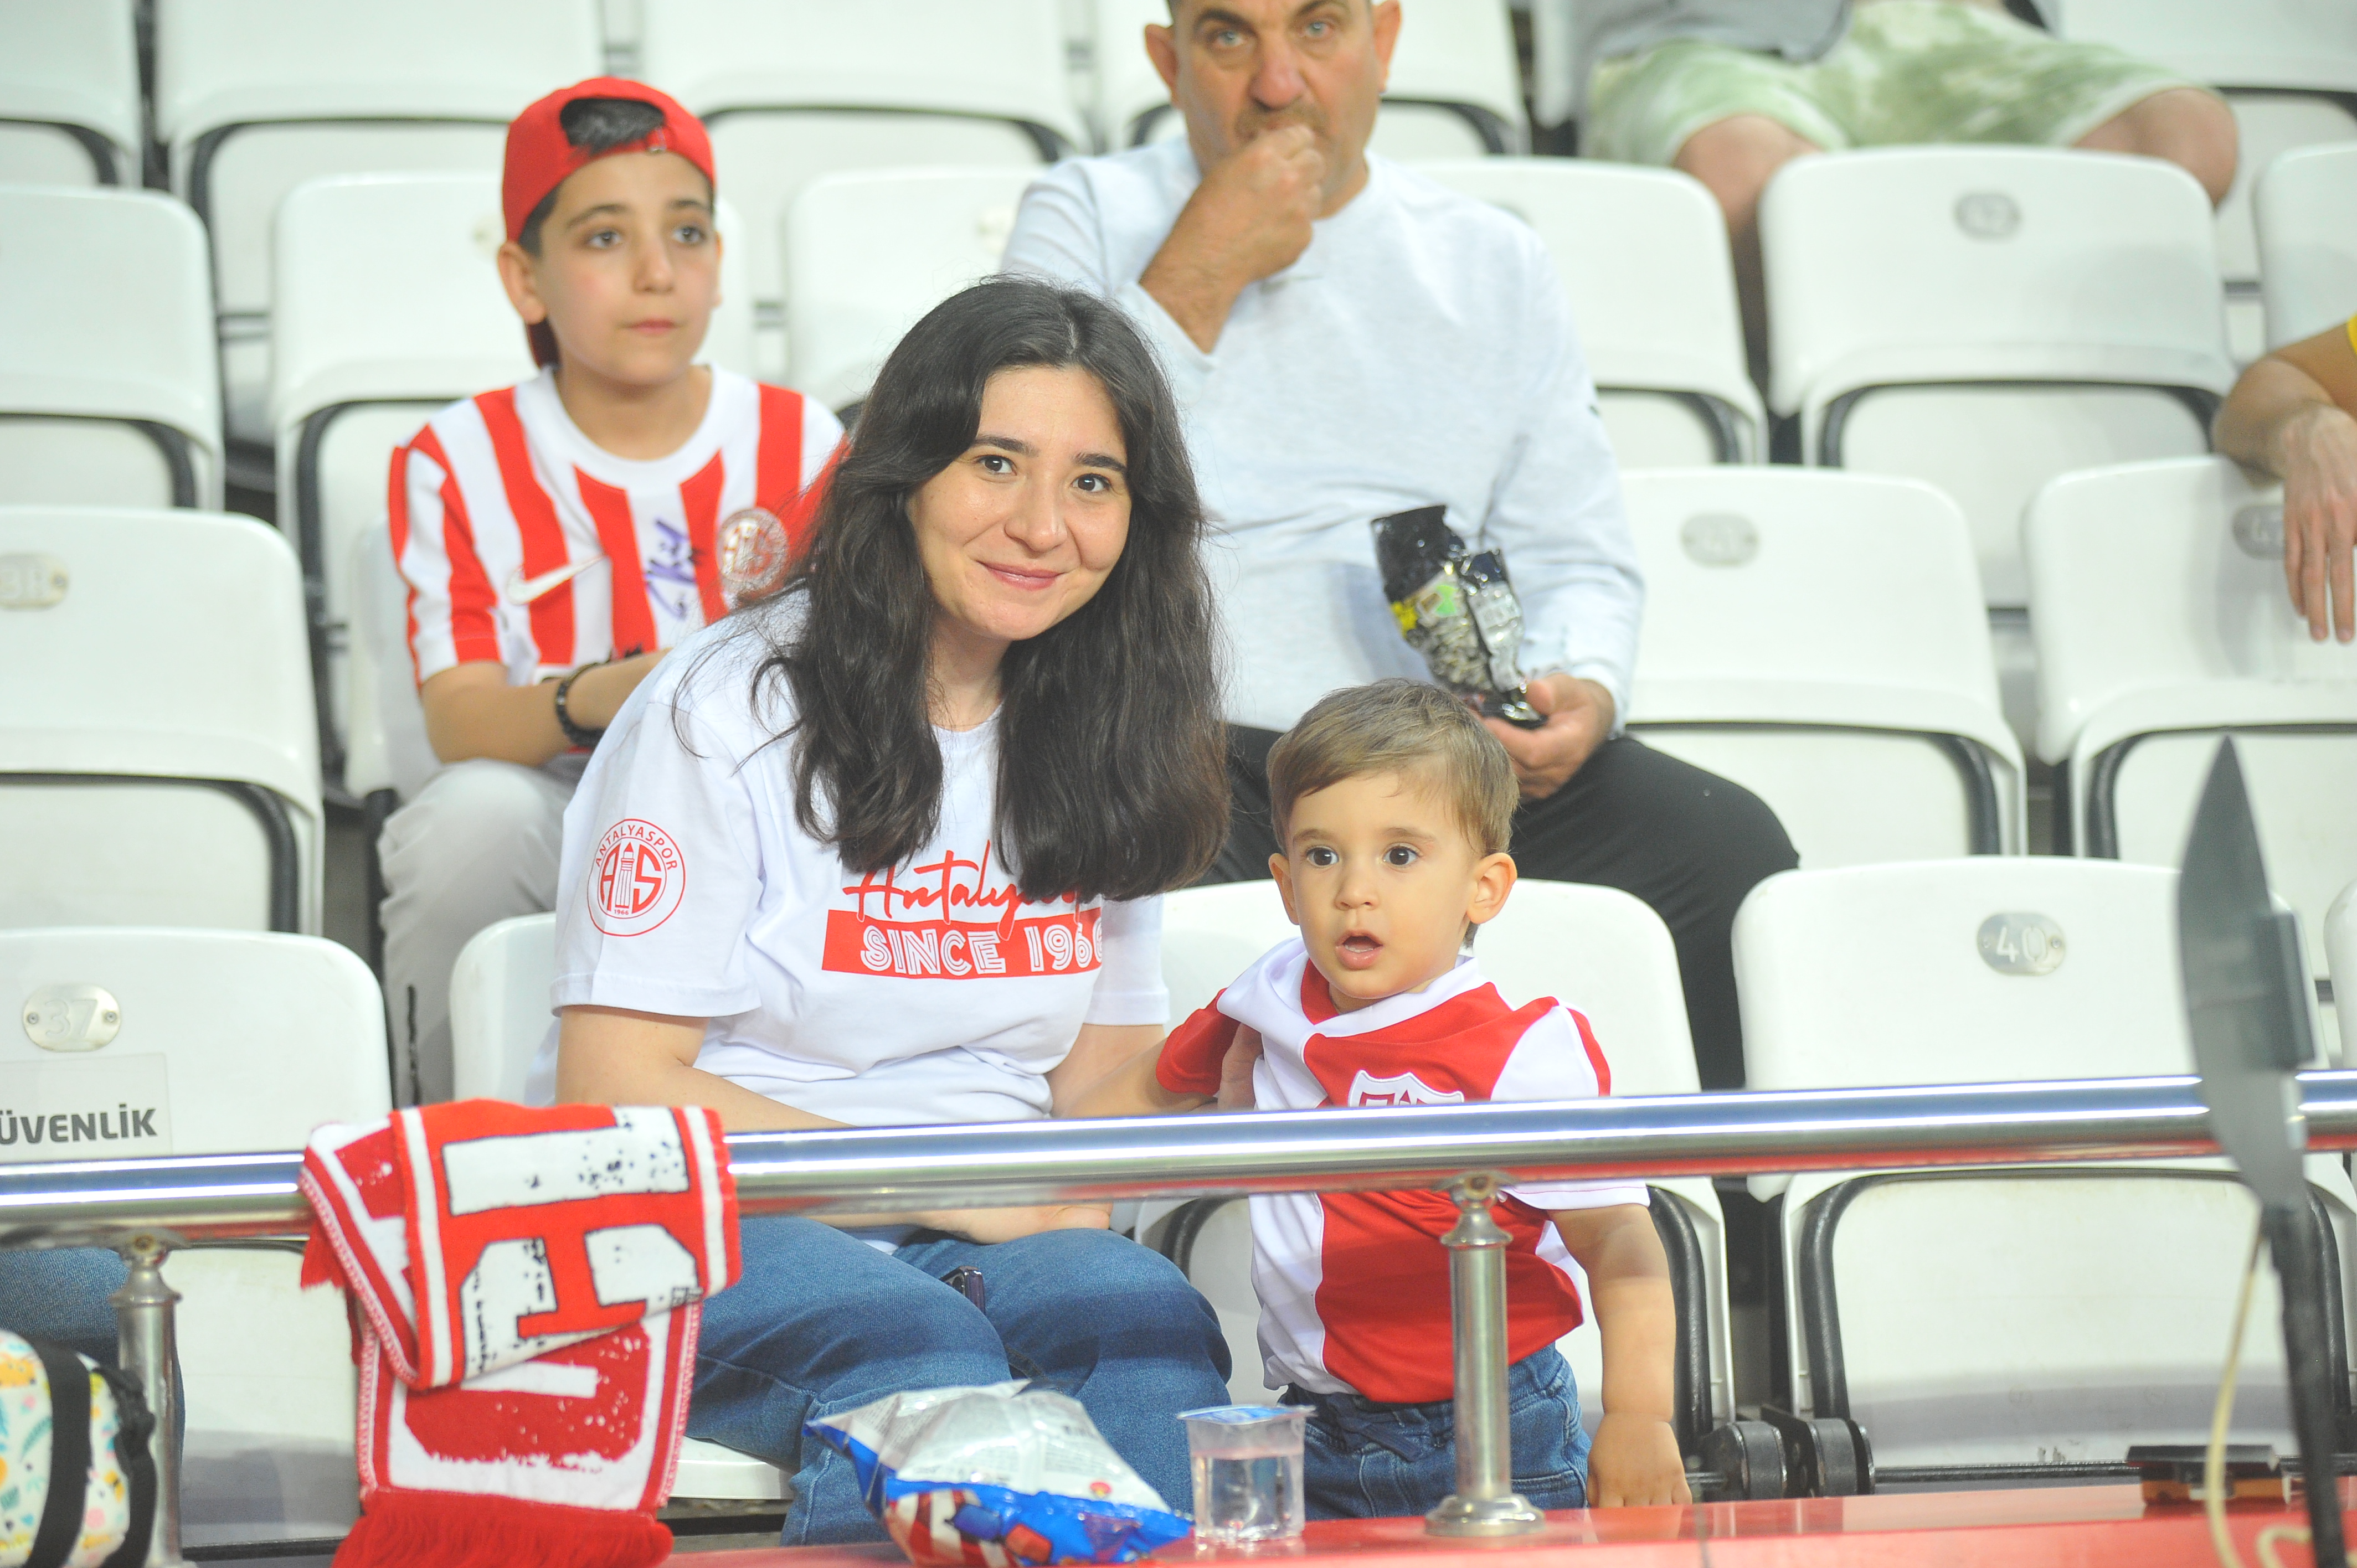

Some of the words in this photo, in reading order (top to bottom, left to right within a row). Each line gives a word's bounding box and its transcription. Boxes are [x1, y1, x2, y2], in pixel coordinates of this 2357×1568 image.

[595, 824, 678, 870] ANTALYASPOR
[842, 839, 1081, 941] Antaly
[860, 925, 1006, 976] SINCE
[1996, 926, 2047, 963] 40
[44, 998, 99, 1039] 37
